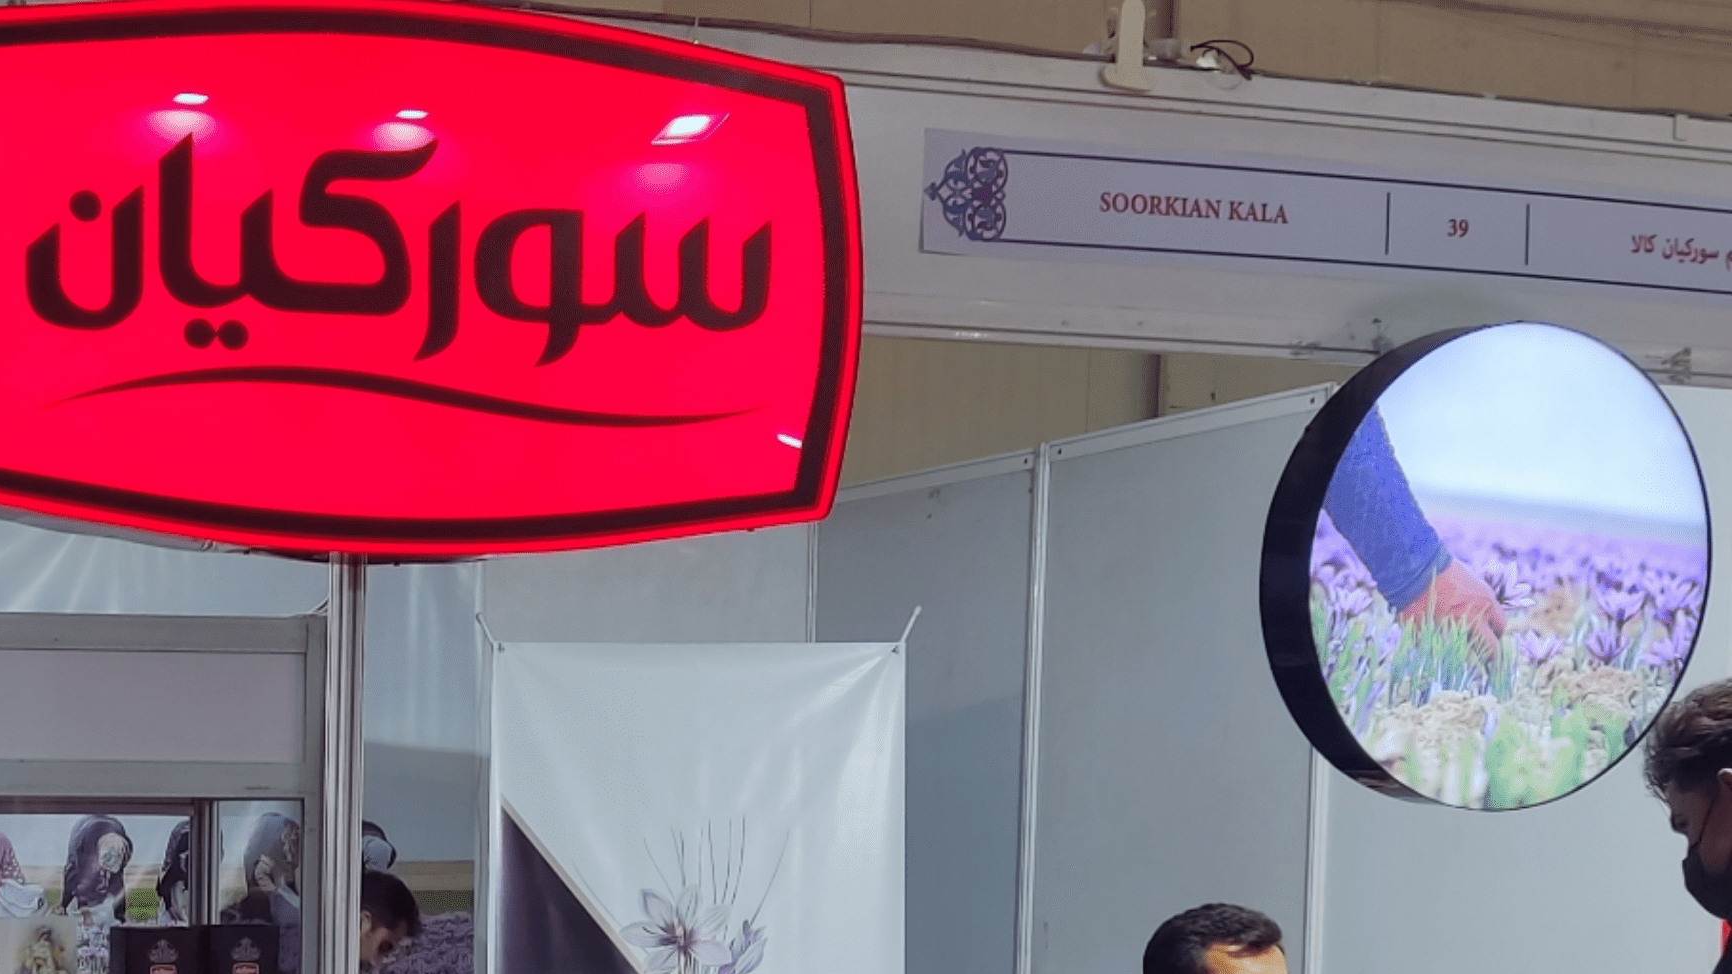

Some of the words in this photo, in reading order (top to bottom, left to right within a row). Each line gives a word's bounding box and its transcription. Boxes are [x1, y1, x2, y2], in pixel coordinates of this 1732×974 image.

[1099, 192, 1222, 219] SOORKIAN
[1228, 200, 1288, 224] KALA
[1447, 218, 1469, 238] 39
[25, 133, 772, 368] سورکیان
